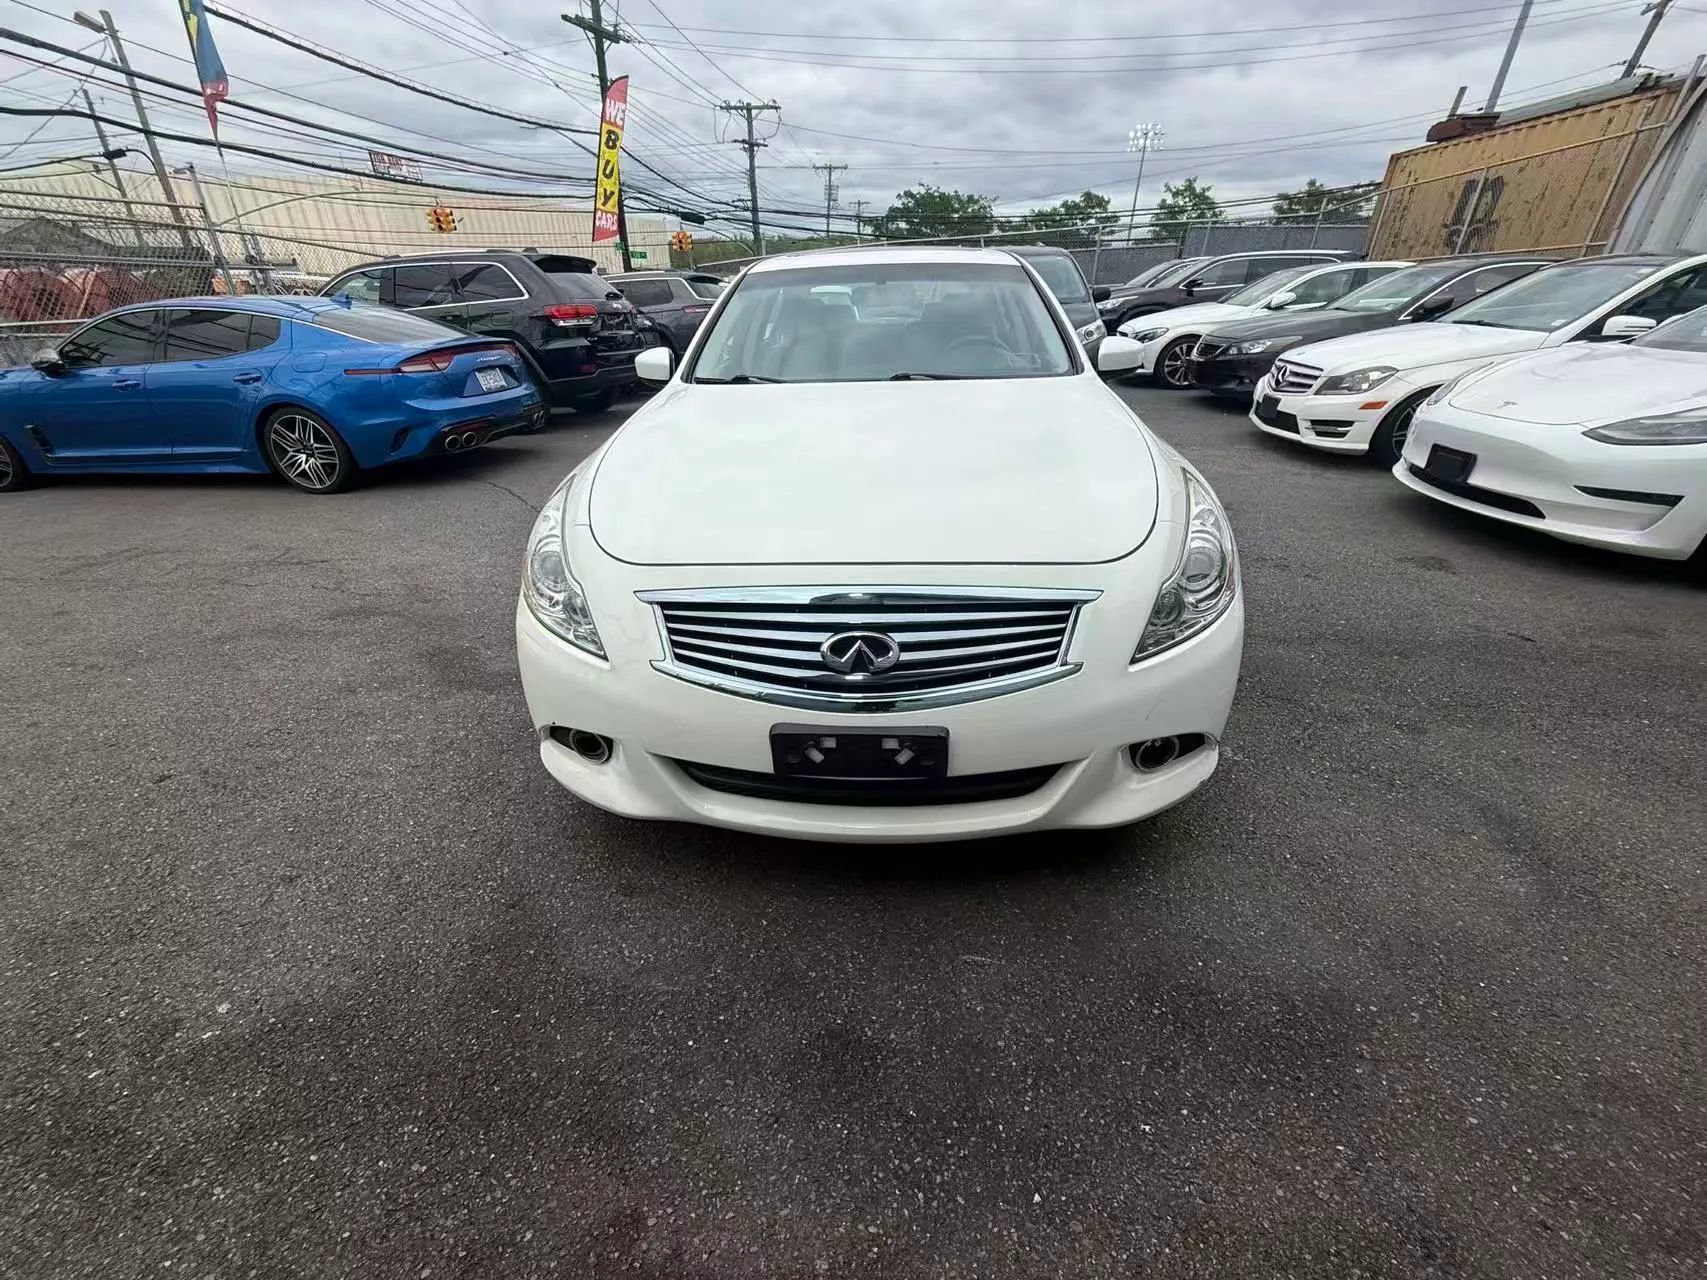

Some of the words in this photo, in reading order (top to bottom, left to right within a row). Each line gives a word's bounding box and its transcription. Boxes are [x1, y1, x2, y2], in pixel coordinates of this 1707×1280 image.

[605, 98, 626, 127] WE
[602, 129, 620, 207] BUY
[595, 209, 618, 231] CARS
